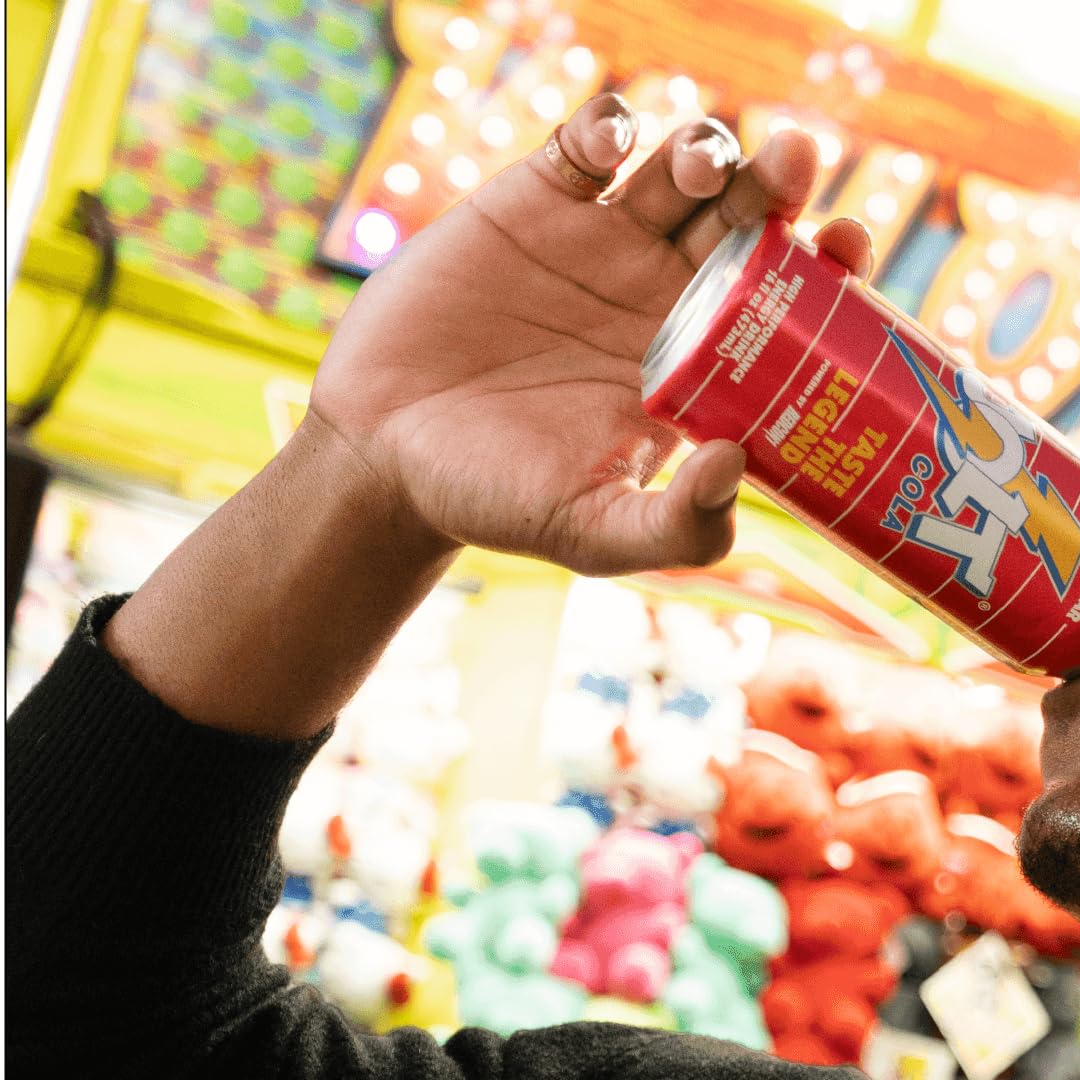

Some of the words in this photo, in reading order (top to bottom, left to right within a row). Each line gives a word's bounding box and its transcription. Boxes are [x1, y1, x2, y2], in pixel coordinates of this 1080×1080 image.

[764, 268, 778, 284] 16
[783, 274, 805, 304] HIGH
[748, 292, 762, 308] oz
[756, 278, 788, 325] ENERGY
[715, 307, 756, 358] (473mL)
[729, 300, 790, 385] PERFORMANCE
[730, 322, 761, 362] DRINK
[803, 358, 831, 397] POWERED
[779, 367, 860, 465] LEGEND
[796, 395, 808, 409] BY
[800, 437, 847, 482] THE
[822, 426, 889, 498] TASTE
[880, 453, 933, 533] COLA
